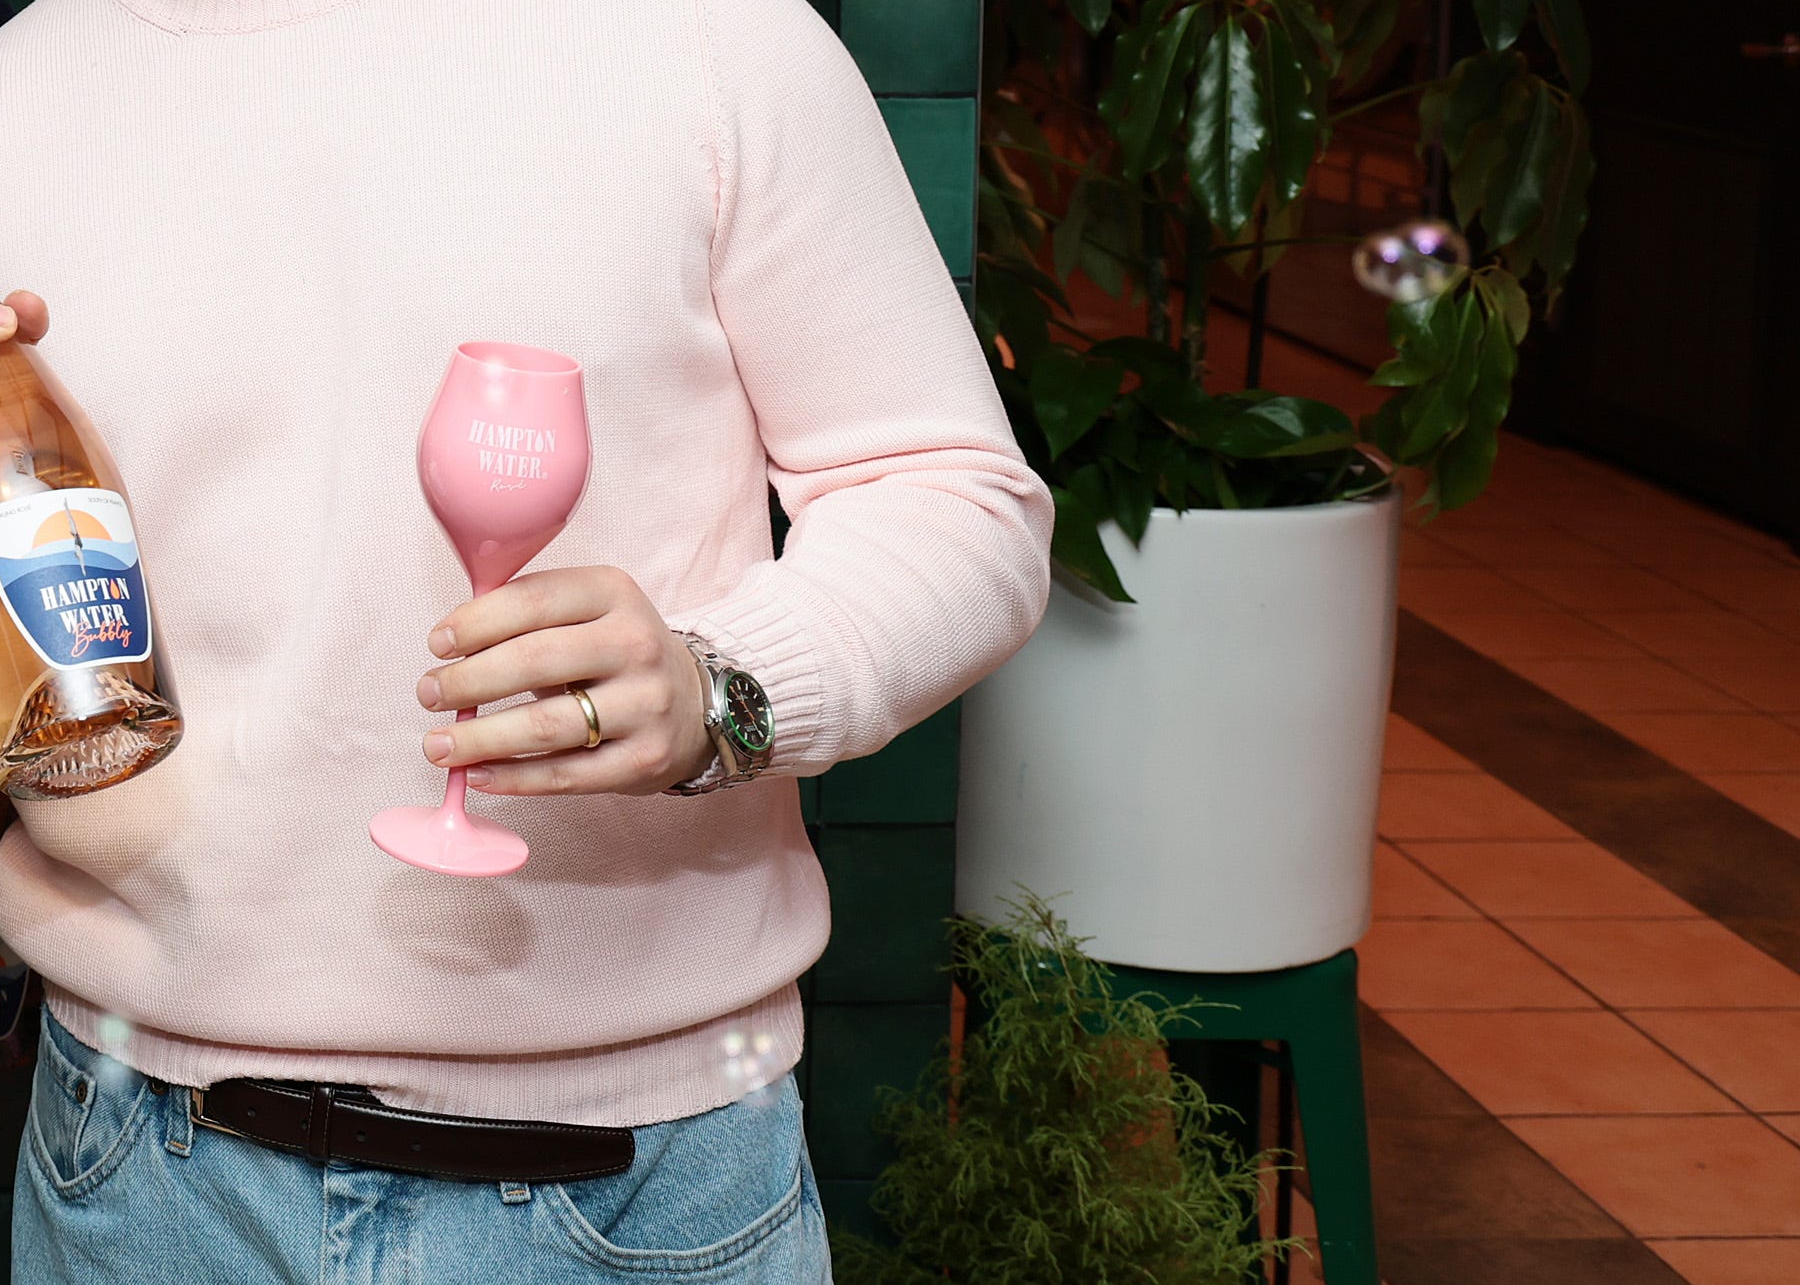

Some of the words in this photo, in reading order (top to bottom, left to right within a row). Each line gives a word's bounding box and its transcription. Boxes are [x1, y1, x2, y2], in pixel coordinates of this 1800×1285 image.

[468, 418, 556, 453] HAMPTON
[479, 449, 541, 479] WATER
[39, 577, 131, 611] HAMPTON
[58, 604, 130, 634] WATER
[70, 619, 133, 657] Bubbly
